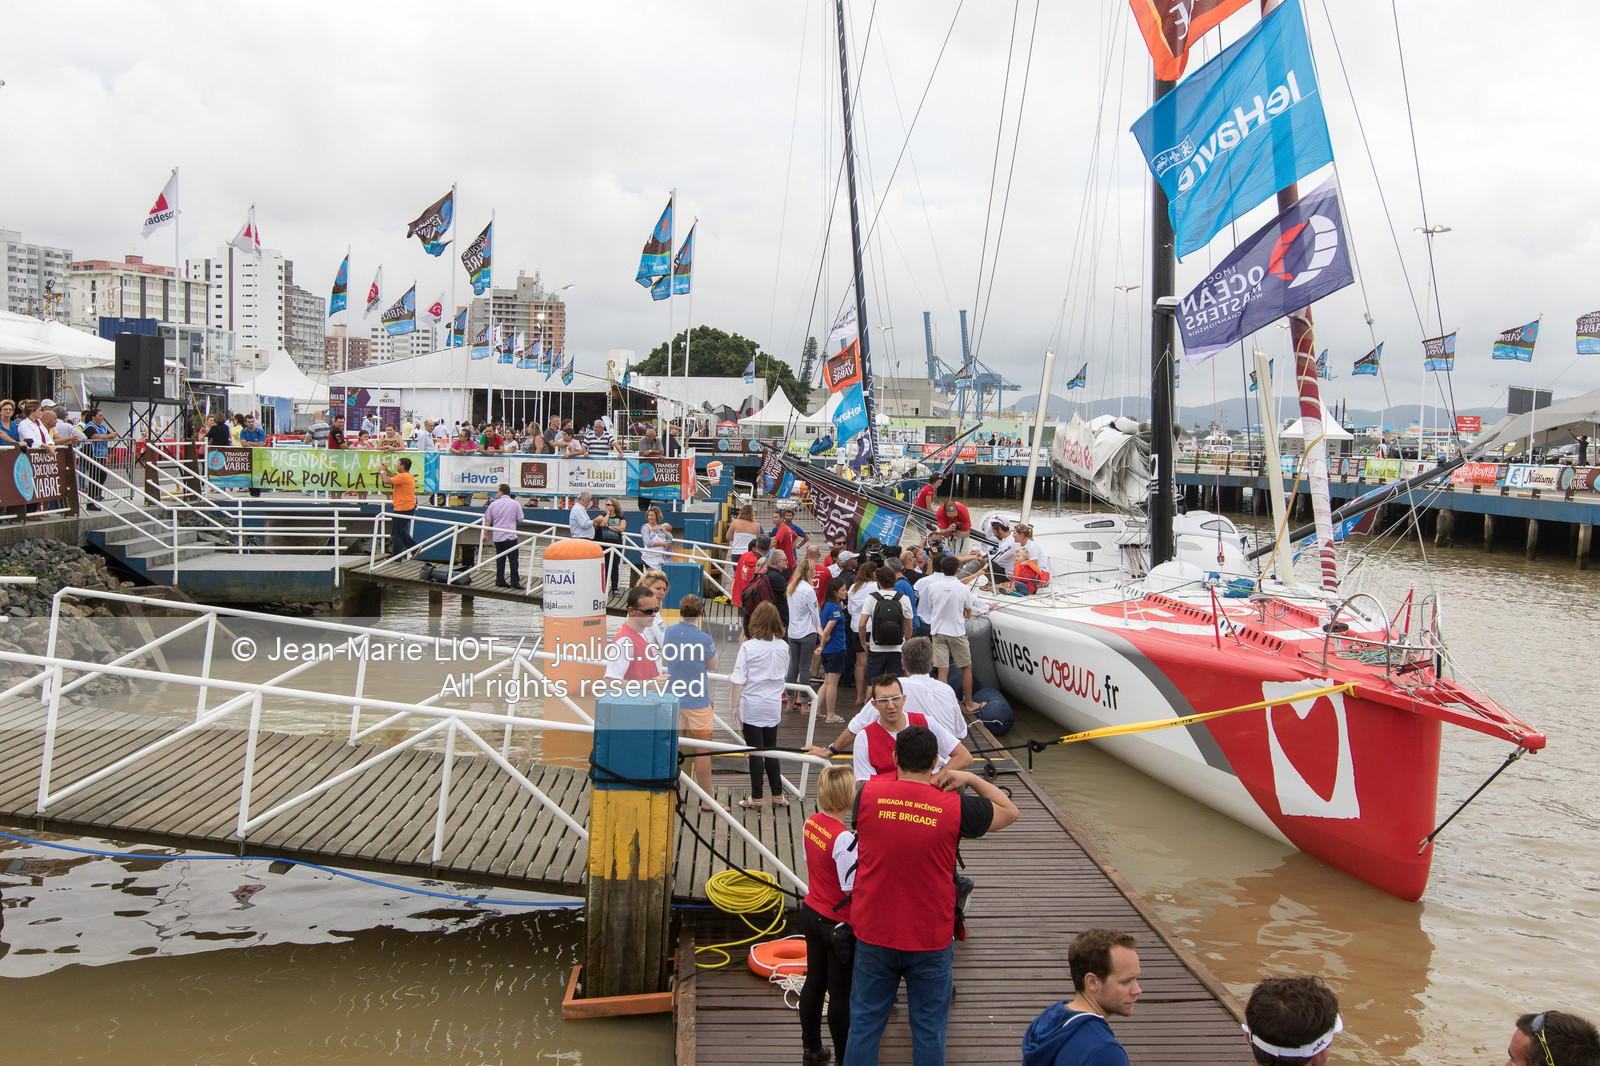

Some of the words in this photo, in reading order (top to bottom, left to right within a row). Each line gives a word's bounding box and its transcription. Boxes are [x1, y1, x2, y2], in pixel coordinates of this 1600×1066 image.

[107, 289, 115, 317] HOT
[30, 452, 58, 463] TRANSAT
[270, 450, 338, 470] PRENDRE
[343, 453, 361, 470] LA
[223, 460, 251, 471] VABRE
[260, 468, 298, 487] AGIR
[302, 470, 343, 487] POUR
[347, 472, 366, 490] LA
[523, 478, 546, 486] VABRE
[586, 468, 617, 482] Itajaí
[653, 472, 680, 482] VABRE
[31, 477, 62, 499] VABRE
[544, 572, 575, 584] ITAJAÍ
[592, 599, 606, 610] Bra
[877, 798, 904, 806] BRIGADA
[914, 802, 943, 814] INCÊNDIO
[878, 810, 897, 820] FIRE
[898, 812, 938, 827] BRIGADE
